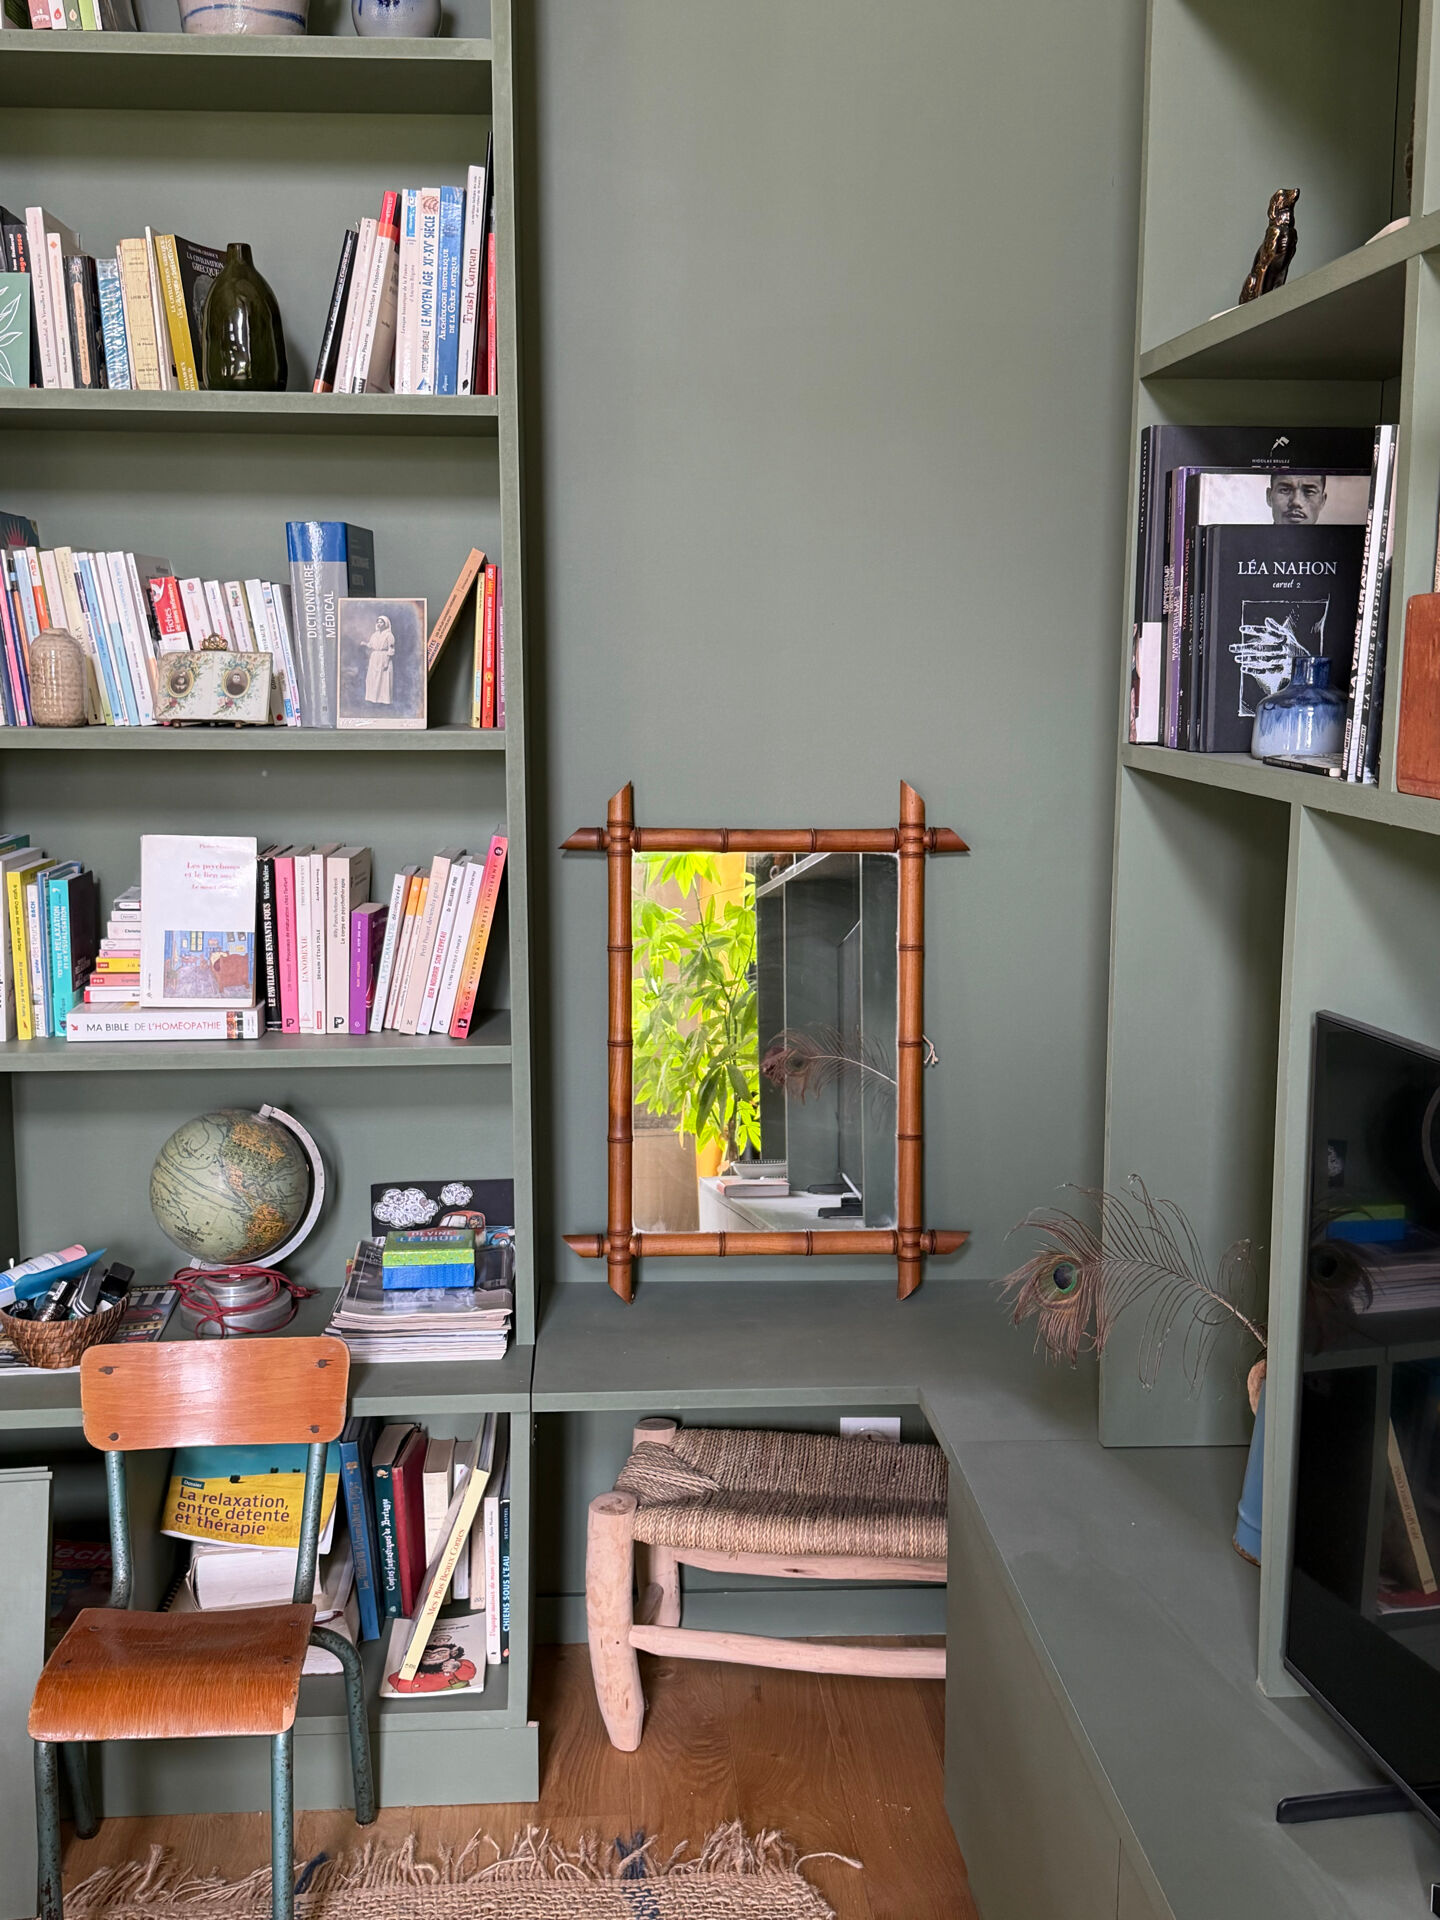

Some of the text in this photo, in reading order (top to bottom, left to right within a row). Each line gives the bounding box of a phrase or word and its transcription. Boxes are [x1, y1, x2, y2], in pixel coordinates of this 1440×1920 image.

[419, 216, 435, 327] LE MOYEN ÂGE SIÈCLE
[450, 256, 458, 287] ANTIQUE
[463, 248, 477, 324] Trash Cancan
[450, 314, 455, 323] LA
[1238, 559, 1337, 575] LÉA NAHON
[304, 564, 317, 638] DICTIONNAIRE
[1349, 508, 1373, 699] LA VEINE GRAPHIQUE
[165, 608, 175, 632] Fiches
[322, 591, 336, 638] MÉDICAL
[1363, 693, 1371, 710] LA
[1370, 552, 1384, 638] GRAPHIQUE
[263, 903, 272, 920] FOUS
[265, 921, 273, 951] ENFANTS
[265, 952, 274, 964] DES
[430, 967, 438, 986] NOURRIR
[437, 931, 447, 953] CERVEAU
[266, 965, 275, 997] PAVILLON
[268, 998, 276, 1007] LE
[463, 991, 471, 1010] YOGA
[87, 1021, 221, 1032] MA BIBLE DE L'HOMÉOPATHIE
[180, 1487, 289, 1510] La relaxation,
[175, 1513, 265, 1536] et thérapie
[177, 1502, 289, 1522] entre détente
[382, 1499, 391, 1526] Bretagne
[386, 1571, 395, 1590] Contes
[426, 1528, 465, 1617] Mes Plus Beaux Contes
